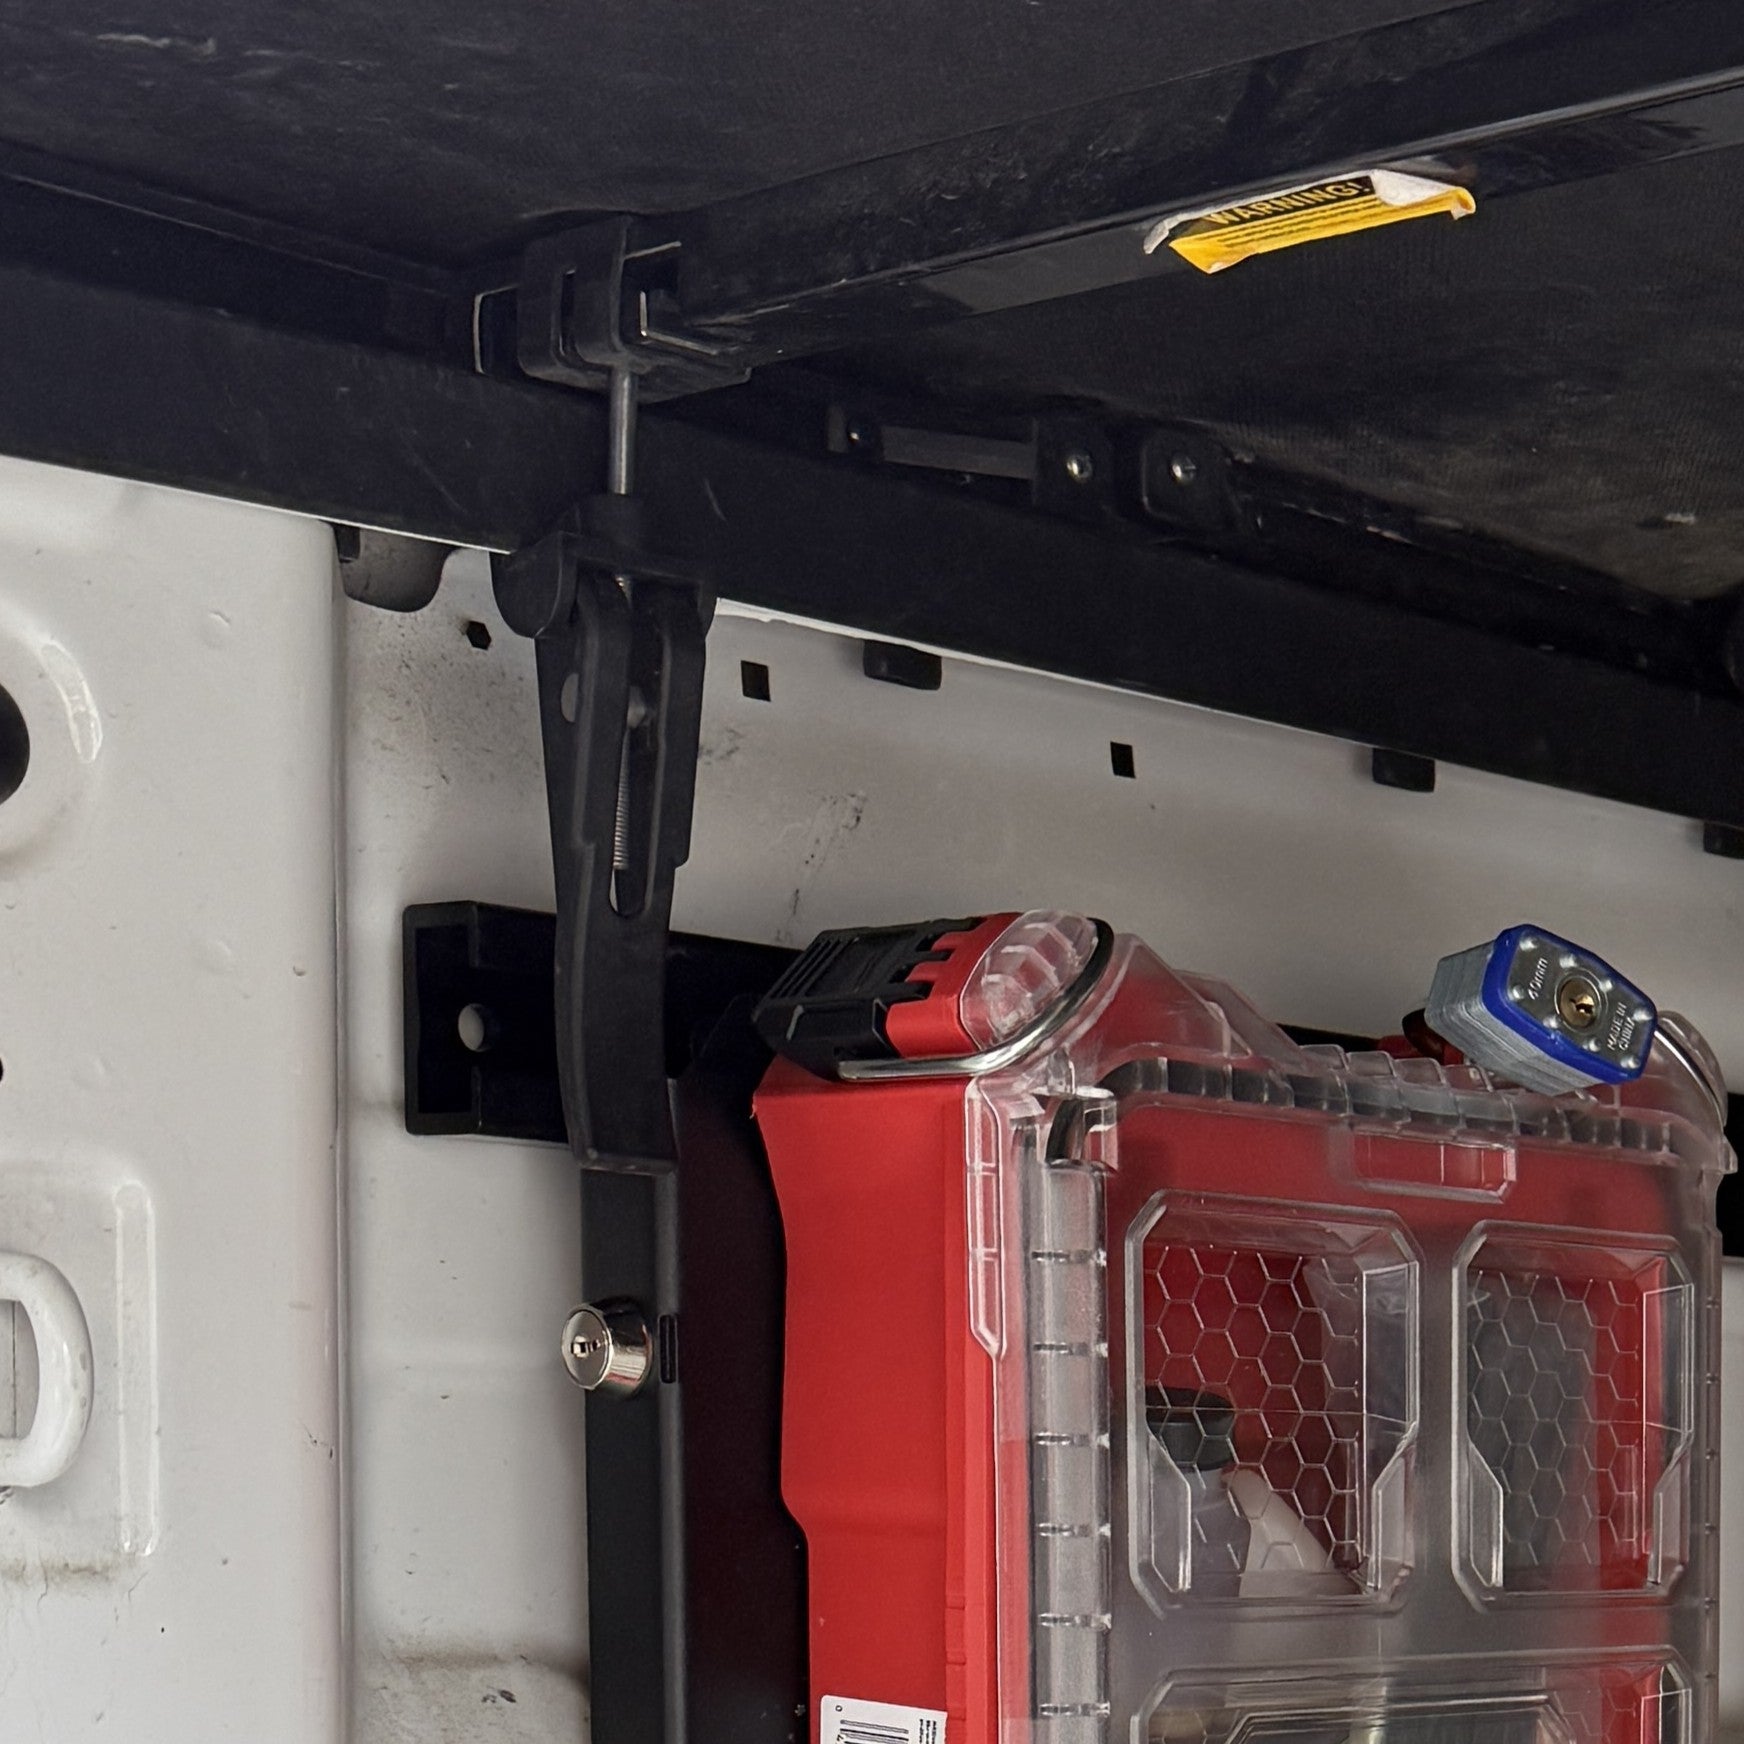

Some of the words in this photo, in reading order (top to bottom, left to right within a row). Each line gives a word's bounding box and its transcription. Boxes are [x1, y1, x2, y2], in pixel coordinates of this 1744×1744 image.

[1204, 180, 1370, 227] WARNING!
[1606, 1016, 1622, 1052] MADE
[1616, 1001, 1628, 1016] IN
[1618, 1016, 1636, 1052] CHINA
